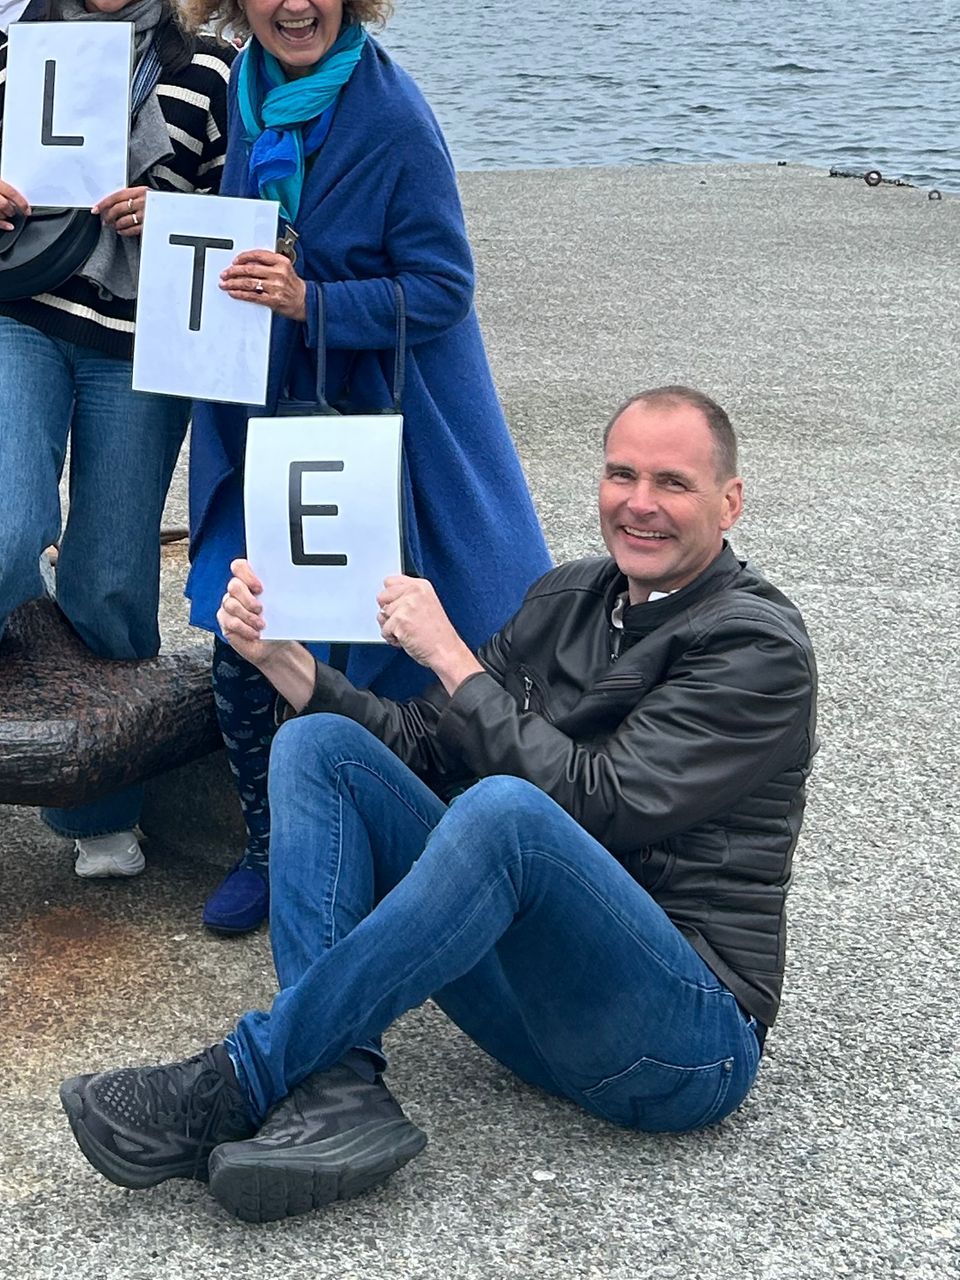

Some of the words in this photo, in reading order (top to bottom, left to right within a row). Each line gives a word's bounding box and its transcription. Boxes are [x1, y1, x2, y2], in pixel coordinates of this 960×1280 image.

[41, 60, 84, 146] L
[169, 234, 233, 331] T
[289, 461, 347, 566] E
